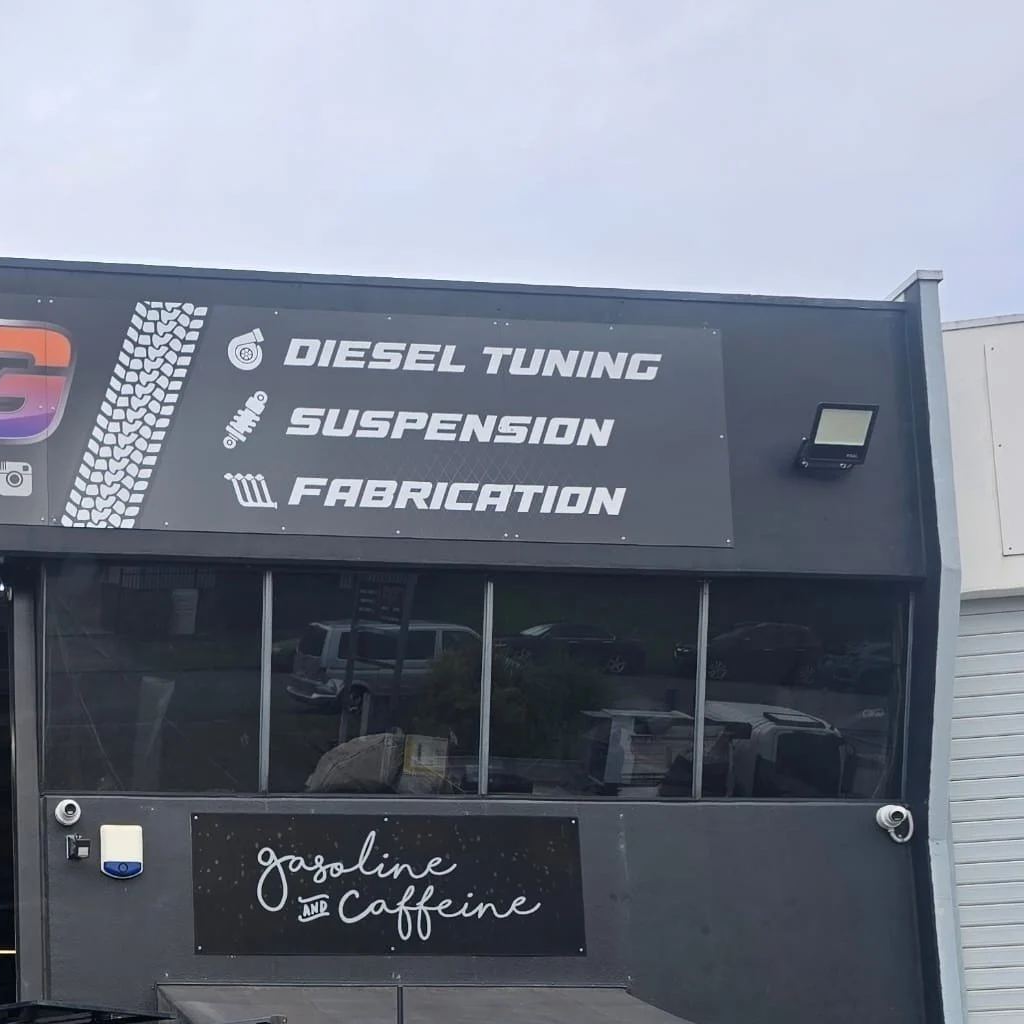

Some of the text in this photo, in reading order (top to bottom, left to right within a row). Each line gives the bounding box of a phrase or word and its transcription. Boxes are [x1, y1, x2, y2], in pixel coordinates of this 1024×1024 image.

[283, 338, 663, 381] DIESEL TUNING
[286, 407, 615, 447] SUSPENSION
[287, 476, 627, 516] FABRICATION
[256, 830, 457, 912] gasoline
[299, 898, 330, 919] AND
